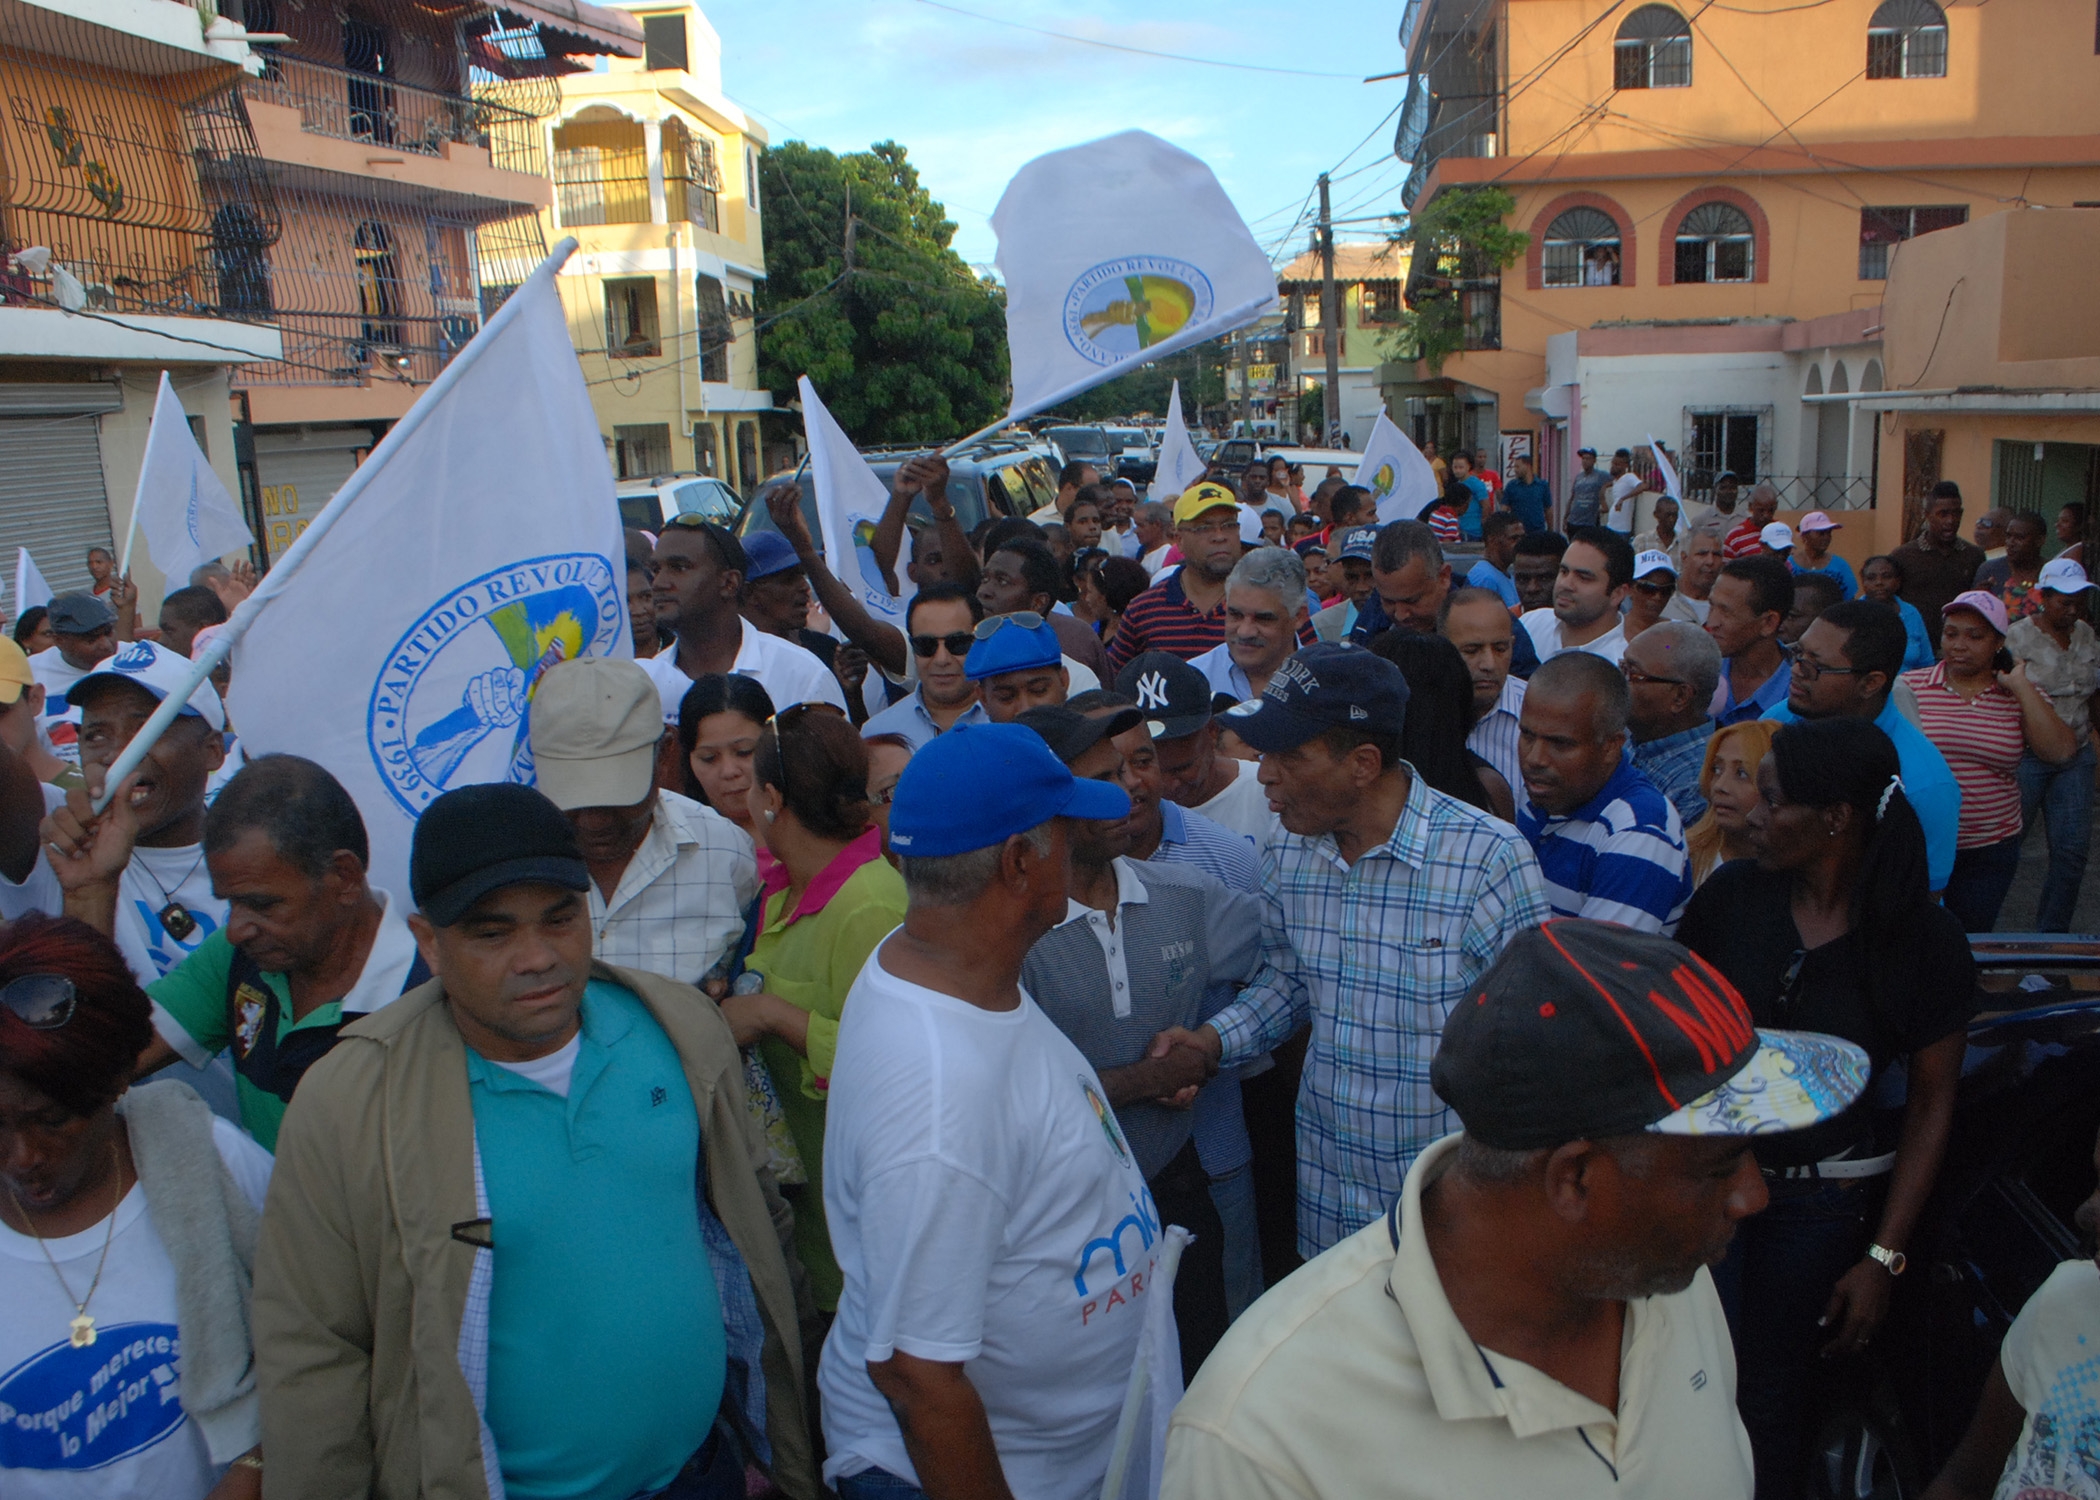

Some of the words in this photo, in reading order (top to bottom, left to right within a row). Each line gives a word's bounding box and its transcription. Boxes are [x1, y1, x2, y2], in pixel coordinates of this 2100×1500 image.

[1073, 264, 1123, 302] PARTIDO
[262, 484, 298, 516] NO
[1347, 530, 1377, 544] USA
[376, 594, 479, 716] PARTIDO
[483, 560, 618, 658] REVOLUCION
[1136, 671, 1169, 709] NY
[380, 736, 422, 792] 1939
[0, 1390, 84, 1433] Porque
[86, 1375, 149, 1445] Mejor
